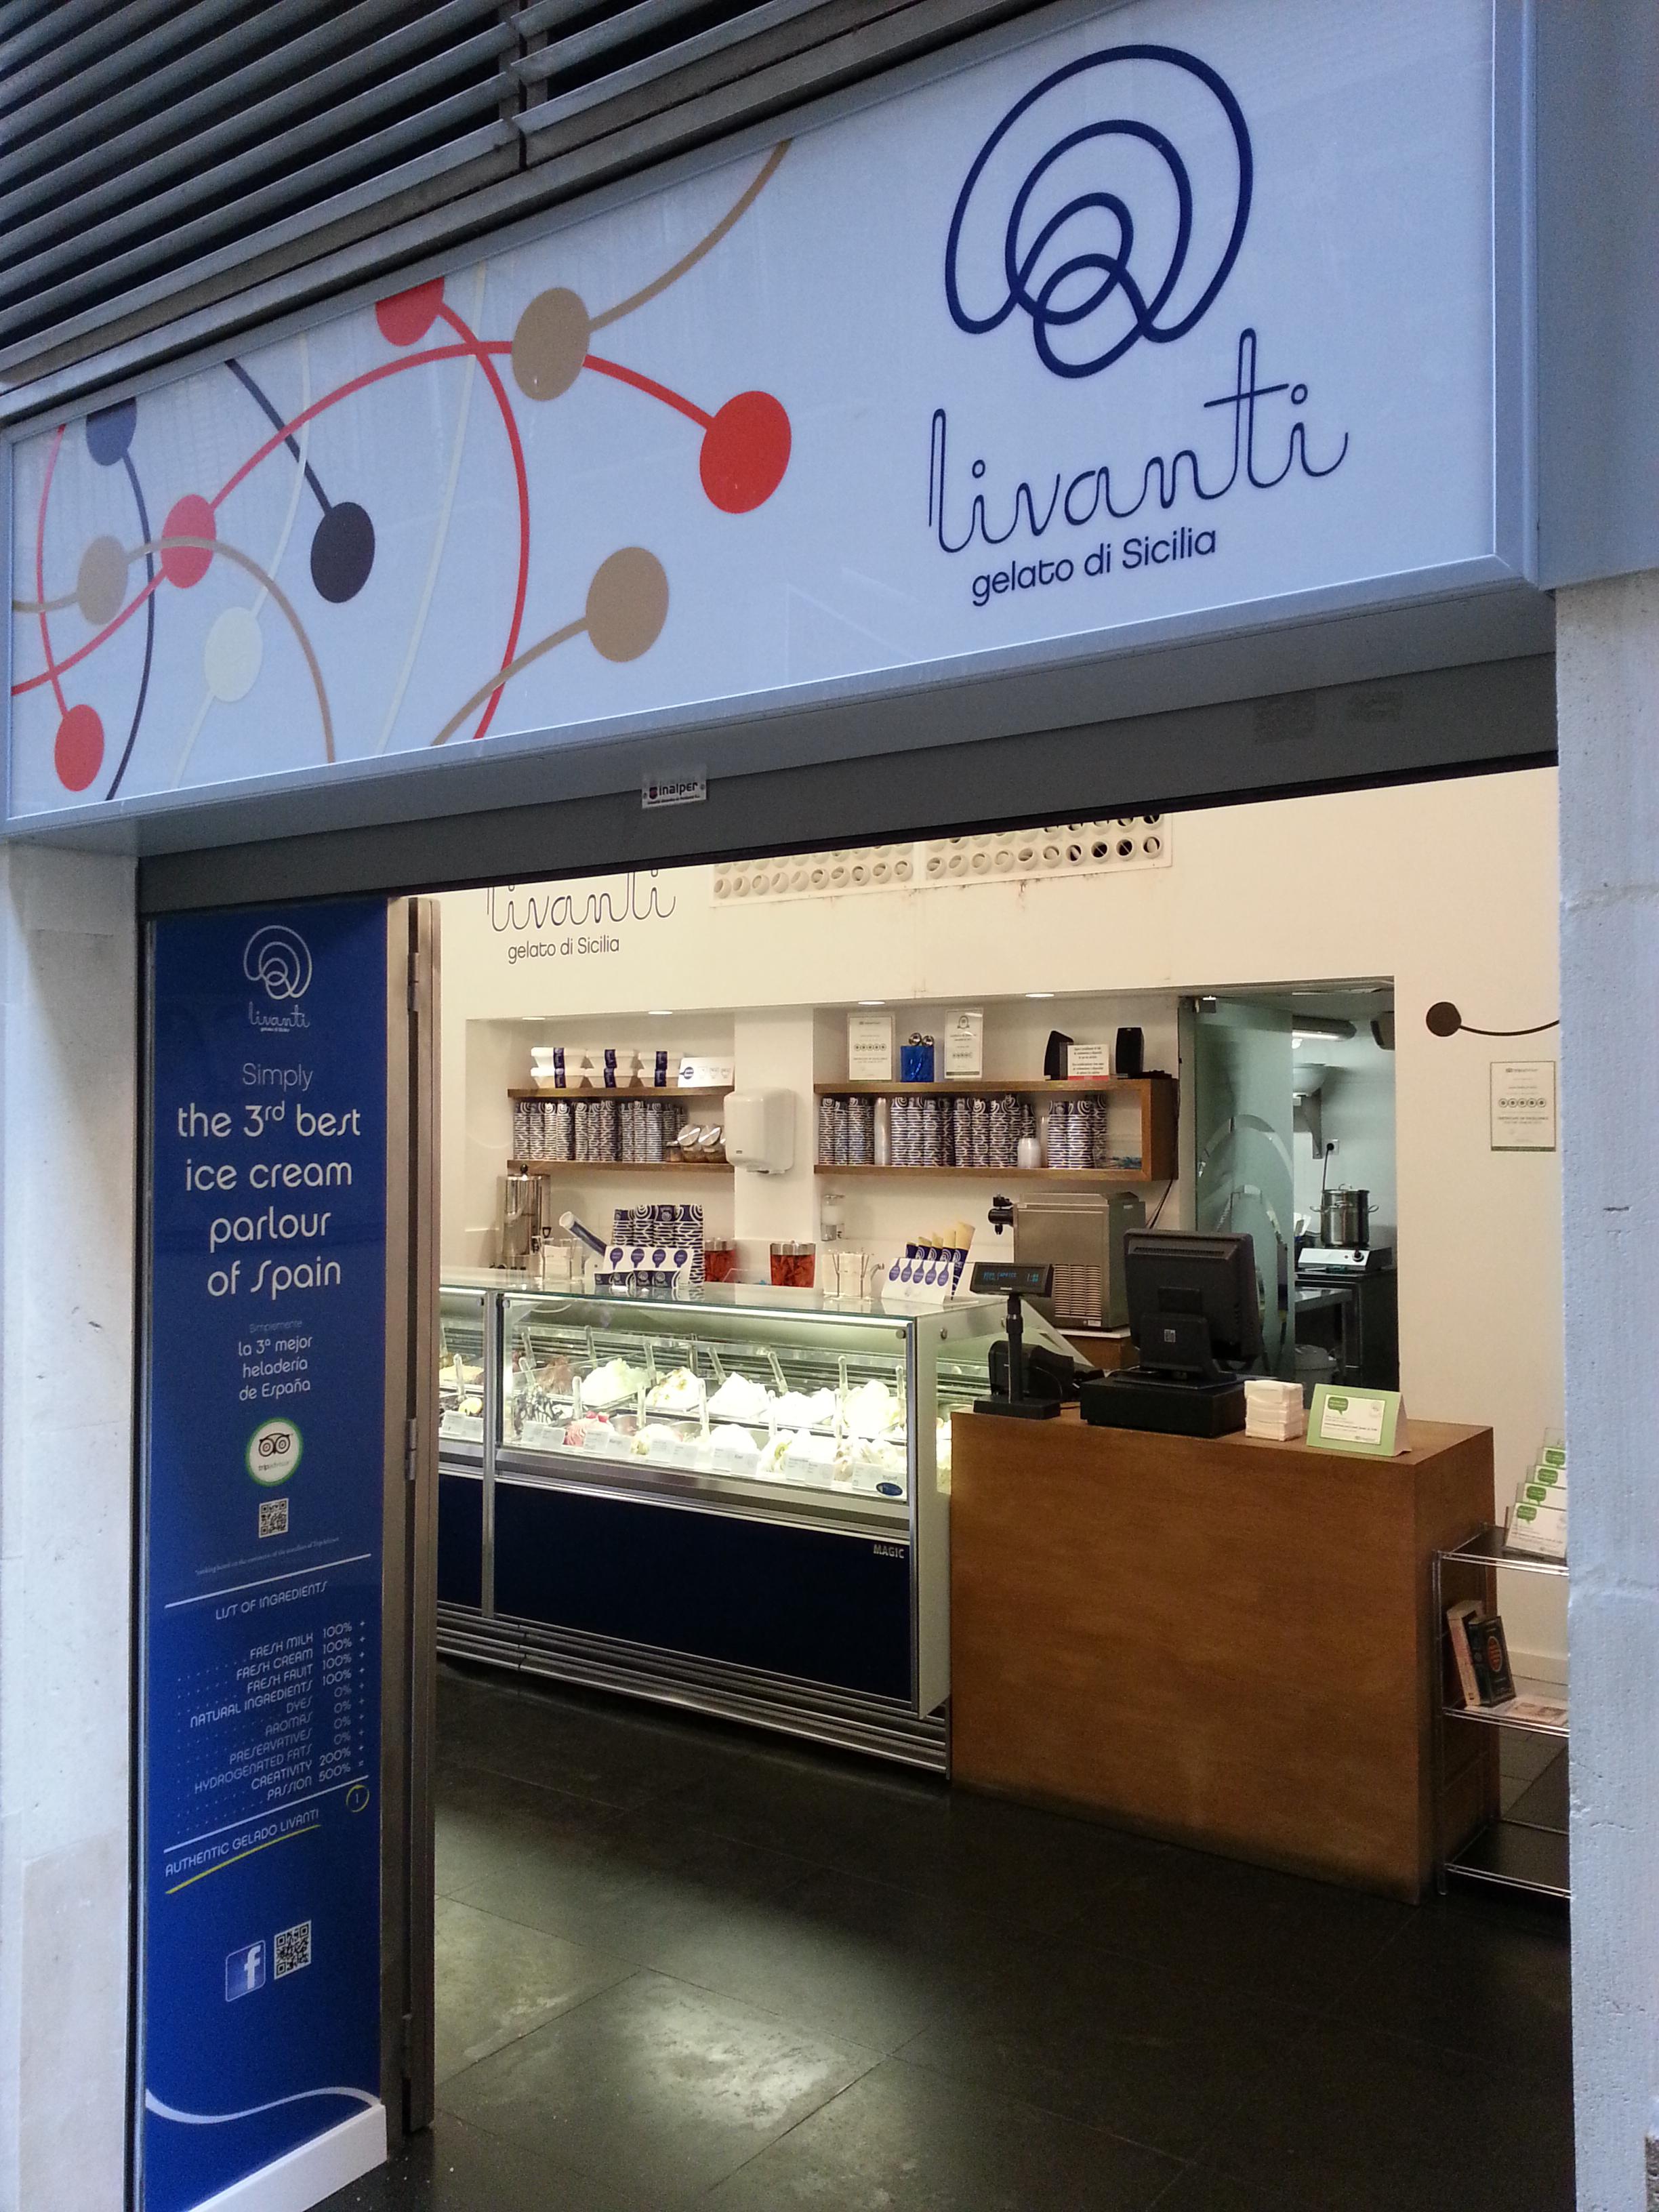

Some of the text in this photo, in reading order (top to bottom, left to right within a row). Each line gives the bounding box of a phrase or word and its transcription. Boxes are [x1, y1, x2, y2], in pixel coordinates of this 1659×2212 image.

[928, 328, 1349, 552] livanti
[971, 526, 1217, 607] gelato di Sicilia
[508, 935, 620, 964] gelato di Sicilia
[242, 1063, 313, 1092] Simply
[178, 1101, 361, 1137] the 3rd best
[186, 1158, 352, 1191] ice cream
[210, 1206, 331, 1254] parlour
[207, 1255, 341, 1300] of Spain
[238, 1340, 252, 1356] la
[274, 1335, 313, 1353] mejor
[243, 1356, 308, 1378] heladería
[239, 1378, 311, 1401] de España
[873, 1544, 905, 1559] MAGIC
[216, 1580, 328, 1620] LIST OF INGREDIENTS
[237, 1637, 352, 1681] FRESH CREAM 100%
[250, 1641, 283, 1660] FRESH
[323, 1622, 352, 1638] 100%
[247, 1654, 352, 1694] FRESH FRUIT 100%
[190, 1669, 352, 1728] NATURAL INGREDIENTS 100%
[286, 1683, 352, 1714] DYES 0%
[265, 1700, 352, 1737] AROMAS 0%
[229, 1715, 352, 1765] PRESERVATIVES 0%
[194, 1731, 351, 1795] HYDROGENATED FATS 0%
[251, 1746, 352, 1790] CREATIVITY 200%
[267, 1762, 351, 1801] PASSION 500%
[165, 1808, 319, 1878] AUTHENTIC GELADO LIVANTI
